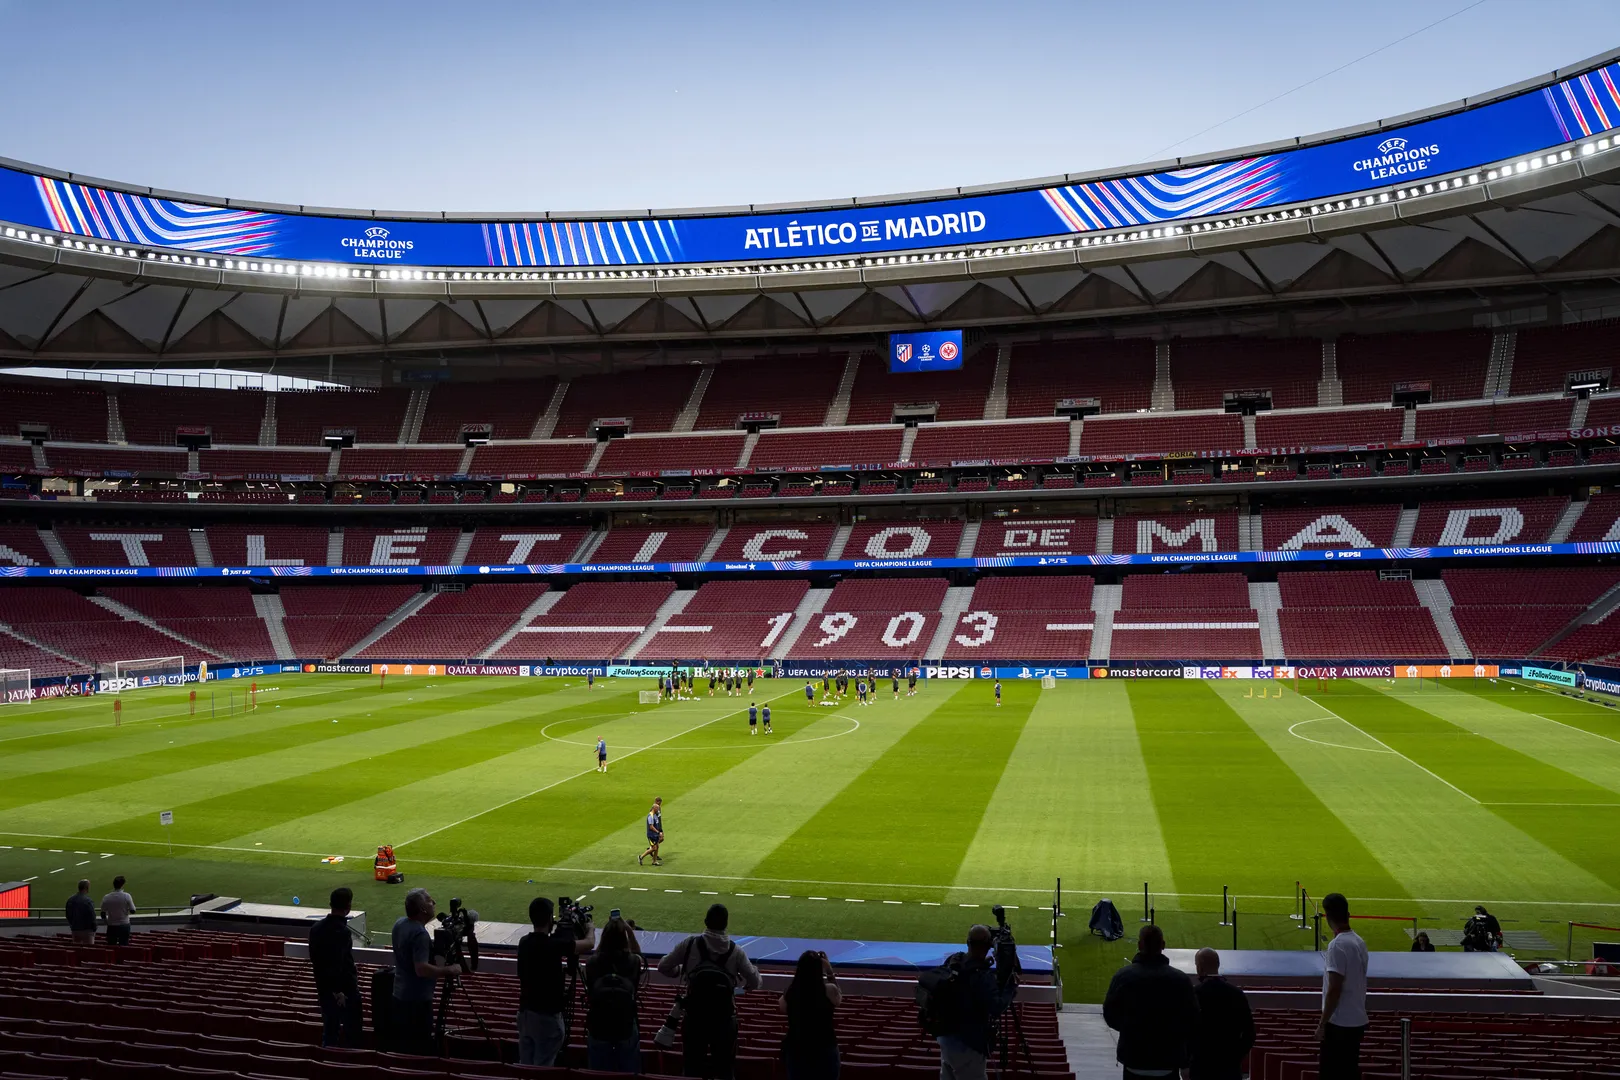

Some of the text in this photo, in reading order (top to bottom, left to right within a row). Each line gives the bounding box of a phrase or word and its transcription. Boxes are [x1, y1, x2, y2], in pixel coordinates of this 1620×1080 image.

[1380, 140, 1406, 153] UEFA
[1353, 144, 1440, 171] CHAMPIONS
[1370, 160, 1427, 180] LEAGUE
[366, 229, 388, 238] UEFA
[744, 210, 986, 249] ATLÉTICO DE MADRID
[341, 238, 414, 250] CHAMPIONS
[354, 248, 402, 259] LEAGUE
[1568, 371, 1600, 383] FUTRE
[1169, 451, 1194, 459] CORIA
[1473, 547, 1520, 555] CHAMPIONS
[1521, 545, 1552, 553] LEAGUE
[760, 611, 998, 648] 1903
[242, 666, 264, 676] PS5
[318, 664, 370, 673] mastercard
[448, 666, 518, 676] QATAR AIRWAYS
[617, 668, 687, 677] FollowScores.c
[694, 667, 754, 678] Heieke
[788, 669, 889, 677] UEFA CHAMPNS LEGUE
[926, 667, 975, 678] PEPSI
[1035, 669, 1067, 677] PS5
[1110, 668, 1181, 677] mastercard
[1200, 666, 1238, 678] FedEx
[1252, 666, 1289, 678] FedEx
[1298, 667, 1391, 678] QATAR AIRWAYS
[168, 671, 213, 684] crypto.m
[1529, 670, 1572, 684] FollowScores.com
[98, 676, 138, 692] PEPSI
[1586, 678, 1620, 695] crypto.com
[3, 689, 37, 703] QATAR
